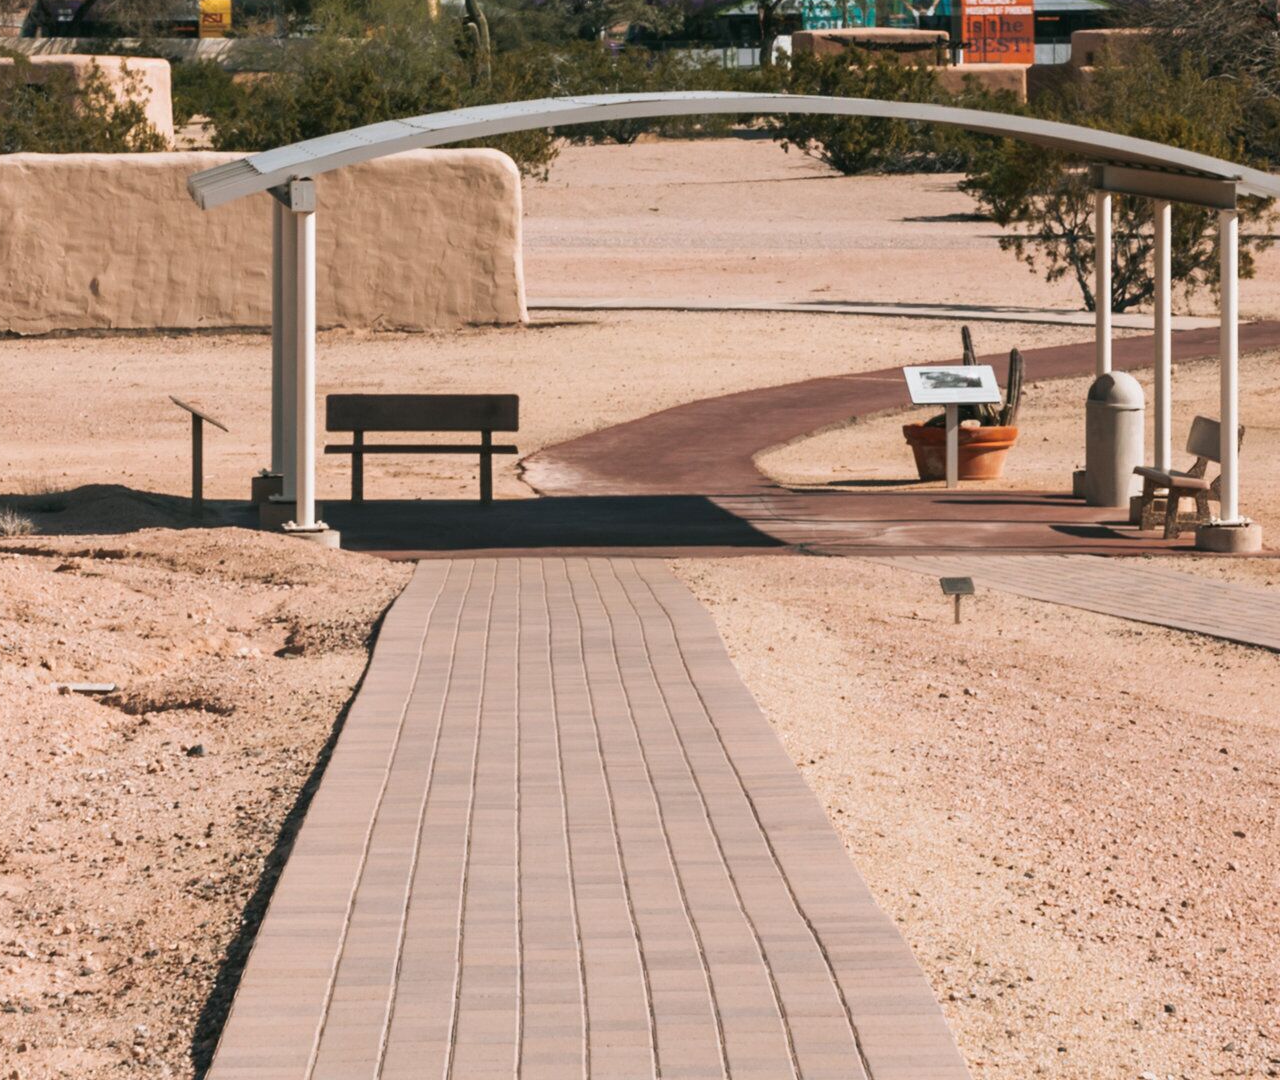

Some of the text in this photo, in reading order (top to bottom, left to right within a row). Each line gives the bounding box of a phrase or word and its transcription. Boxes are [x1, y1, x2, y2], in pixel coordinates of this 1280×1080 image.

[966, 16, 1024, 33] is the
[966, 37, 1031, 53] BEST!
